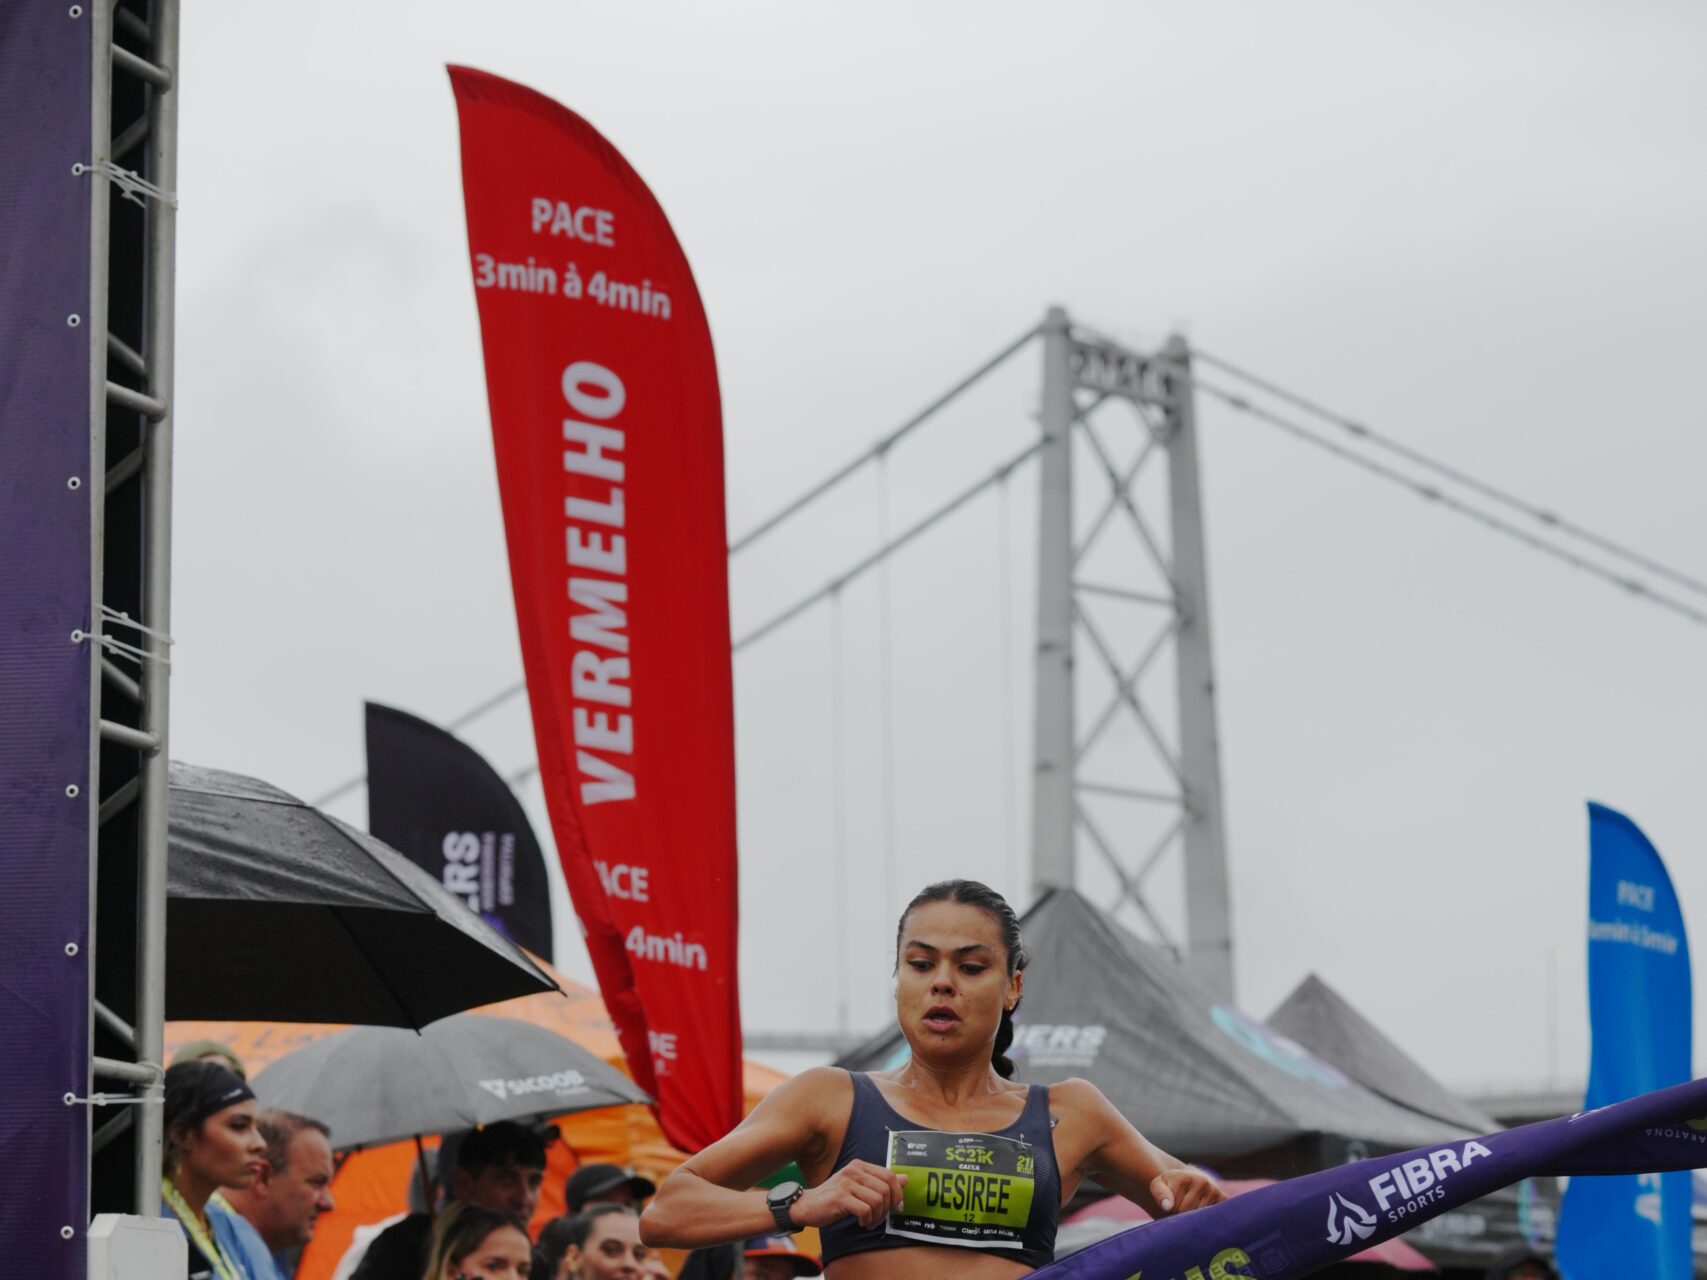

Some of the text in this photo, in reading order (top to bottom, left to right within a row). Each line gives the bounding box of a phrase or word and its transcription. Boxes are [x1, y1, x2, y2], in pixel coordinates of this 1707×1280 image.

[531, 197, 615, 247] PACE
[475, 253, 671, 320] 3min à 4min
[561, 361, 637, 806] VERMELHO
[443, 831, 481, 913] RS
[625, 926, 708, 971] 4min
[1645, 1128, 1707, 1144] ARATONA
[927, 1172, 1011, 1214] DESIREE
[1368, 1141, 1493, 1213] FIBRA
[964, 1213, 976, 1223] 12
[1387, 1184, 1447, 1224] SPORTS
